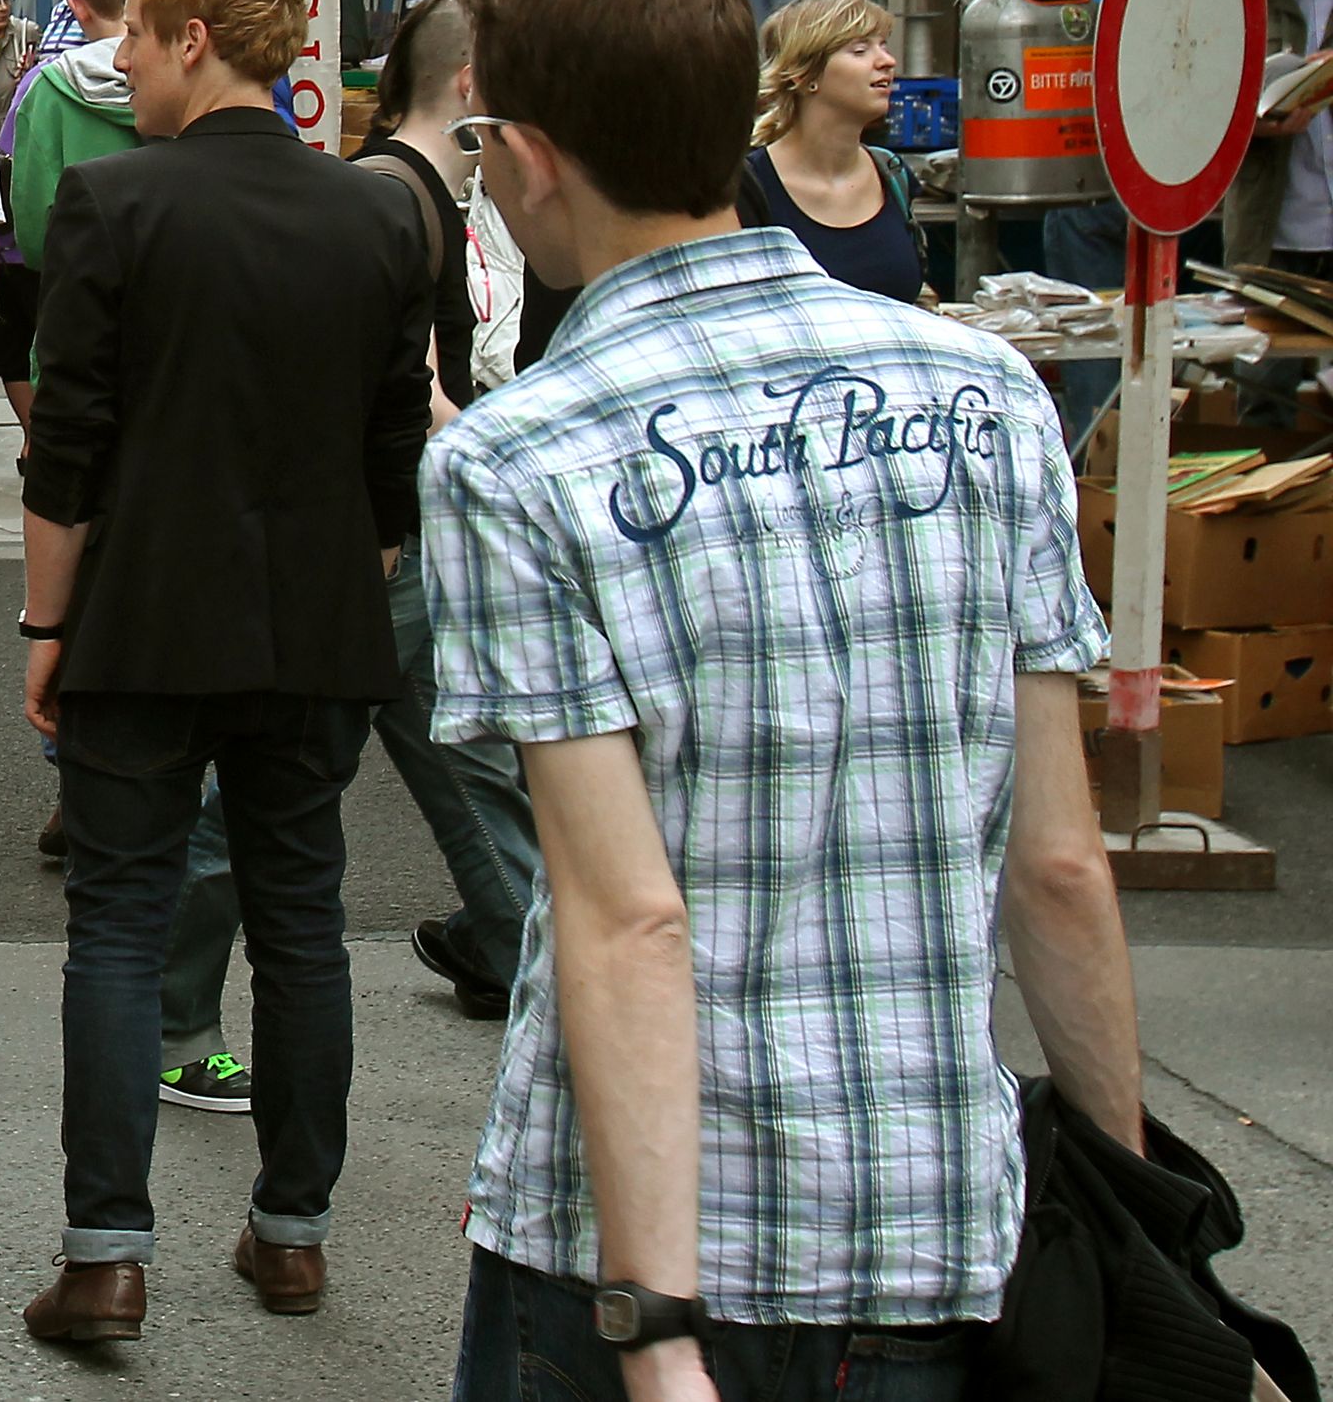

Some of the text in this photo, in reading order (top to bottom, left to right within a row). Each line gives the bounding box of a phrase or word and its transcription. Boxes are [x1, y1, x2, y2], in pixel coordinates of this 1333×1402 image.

[1031, 73, 1067, 89] BITTE
[610, 373, 809, 543] South
[783, 368, 999, 518] Pacific
